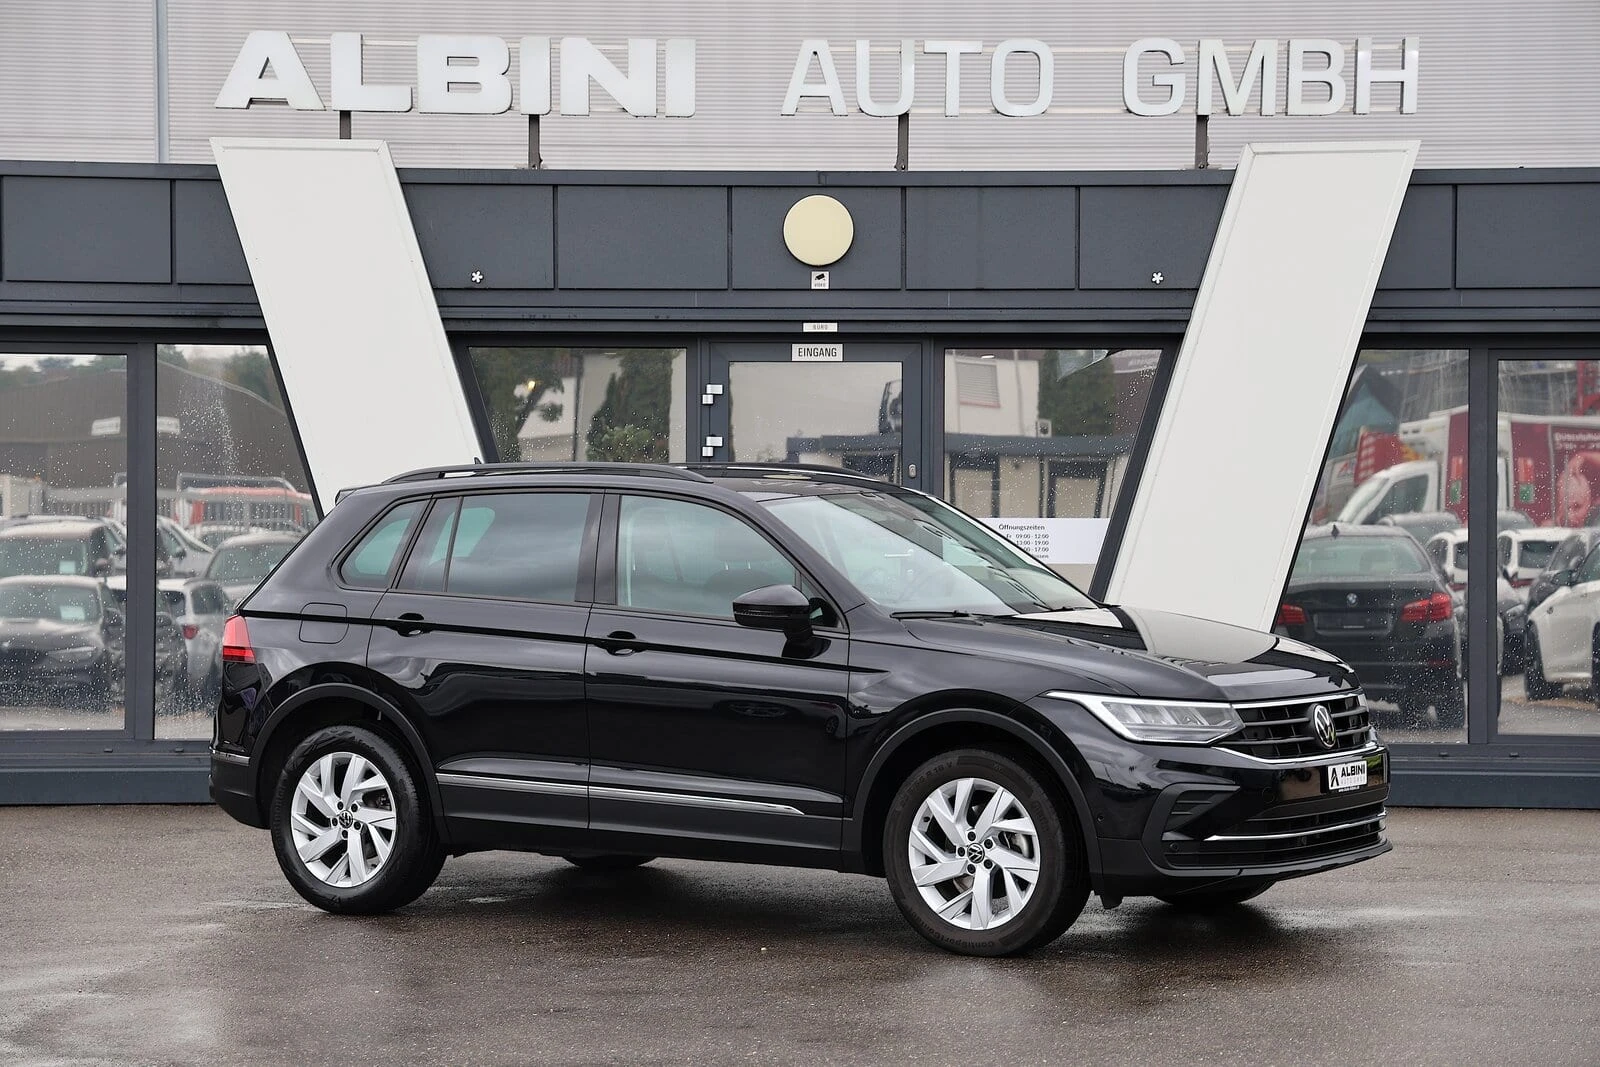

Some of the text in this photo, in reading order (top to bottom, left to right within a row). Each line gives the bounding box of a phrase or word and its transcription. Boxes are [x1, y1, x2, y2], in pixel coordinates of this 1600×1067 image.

[215, 31, 1420, 117] ALBINI AUTO GMBH
[798, 347, 837, 357] EINGANG
[1341, 764, 1366, 778] ALBINI
